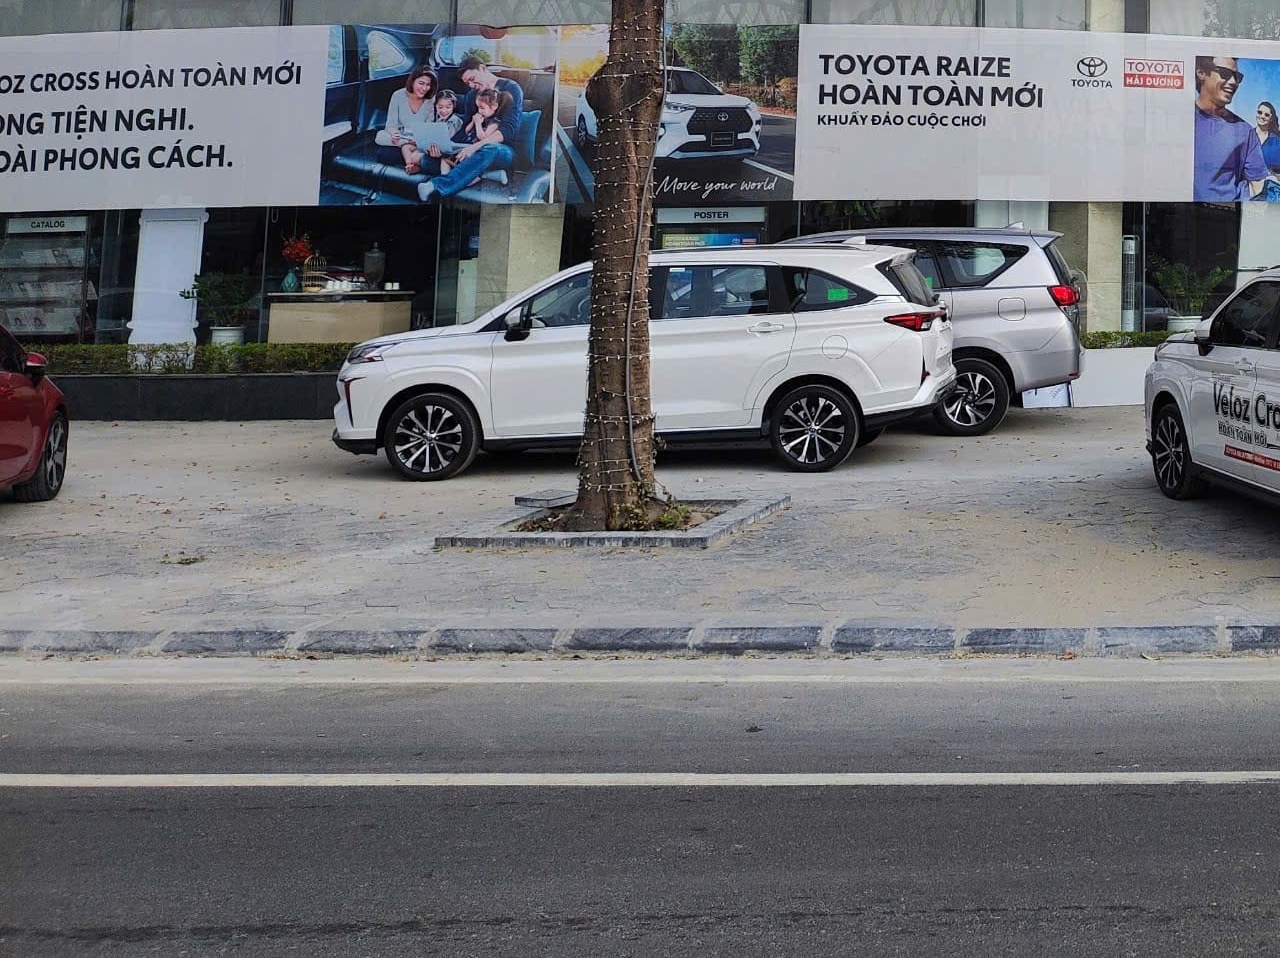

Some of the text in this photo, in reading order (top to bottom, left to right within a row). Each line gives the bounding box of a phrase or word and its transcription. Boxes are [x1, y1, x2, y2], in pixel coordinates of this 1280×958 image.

[30, 71, 100, 92] CROSS
[105, 64, 175, 90] HOÀN
[181, 62, 247, 87] TOÀN
[253, 60, 302, 85] MỚI
[819, 54, 1011, 77] TOYOTA RAIZE
[1127, 61, 1181, 74] TOYOTA
[819, 79, 1044, 108] HOÀN TOÀN MỚI
[1071, 79, 1113, 89] TOYOTA
[0, 104, 195, 140] NG TIỆN NGHI.
[817, 110, 986, 129] KHUẤY ĐẢO CUỘC CHƠI
[44, 147, 141, 172] PHONG
[148, 139, 233, 169] CÁCH.
[655, 175, 778, 198] Move your world
[31, 220, 65, 229] CATALOG
[694, 211, 729, 219] POSTER
[1213, 380, 1250, 422] Veloz
